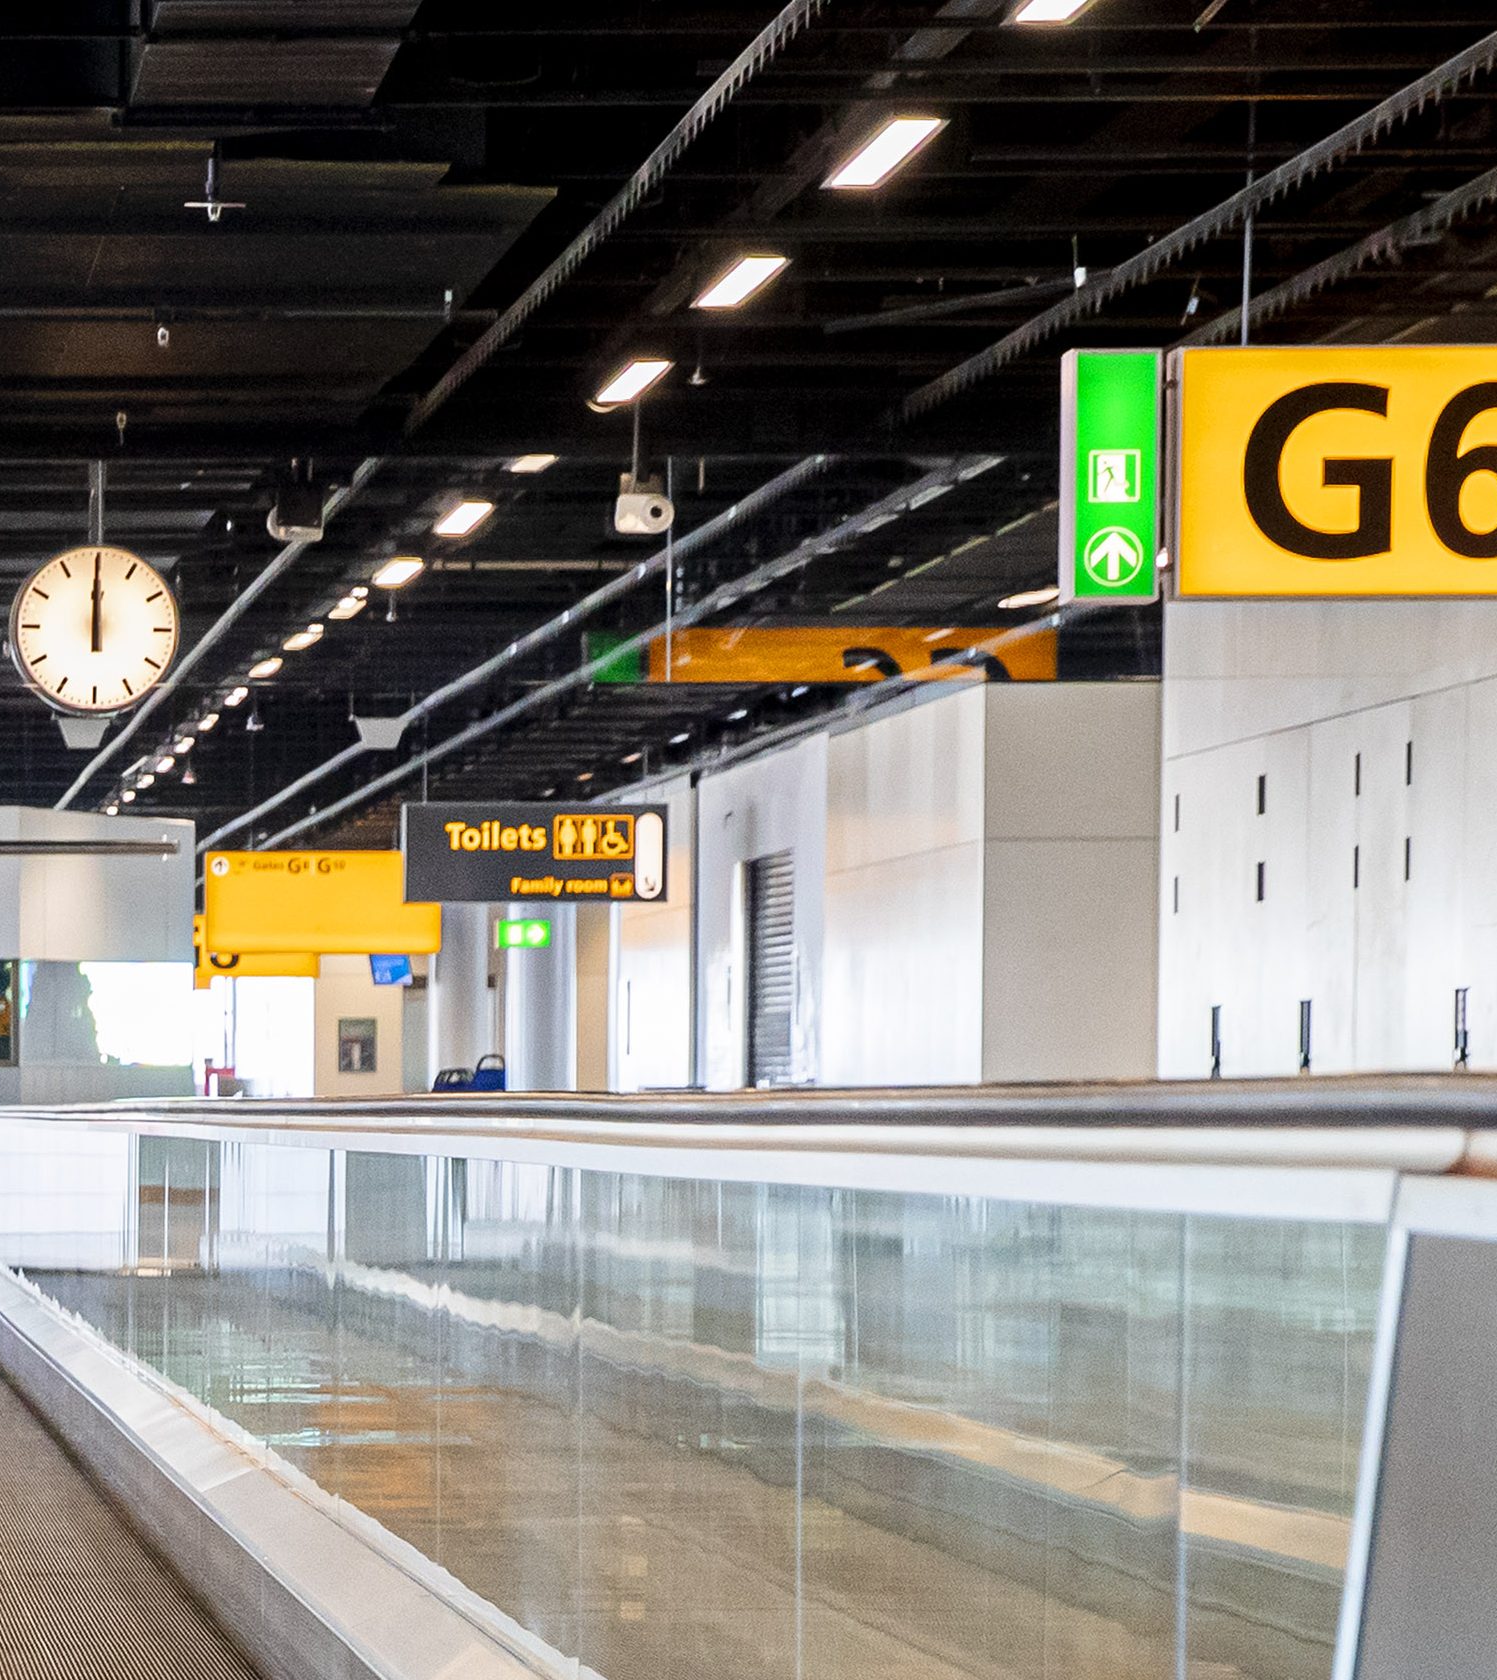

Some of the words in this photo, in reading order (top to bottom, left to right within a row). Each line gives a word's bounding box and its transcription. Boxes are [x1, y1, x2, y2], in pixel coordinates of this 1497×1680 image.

[444, 820, 548, 851] Toilets
[511, 875, 563, 897] Family
[565, 879, 608, 893] room
